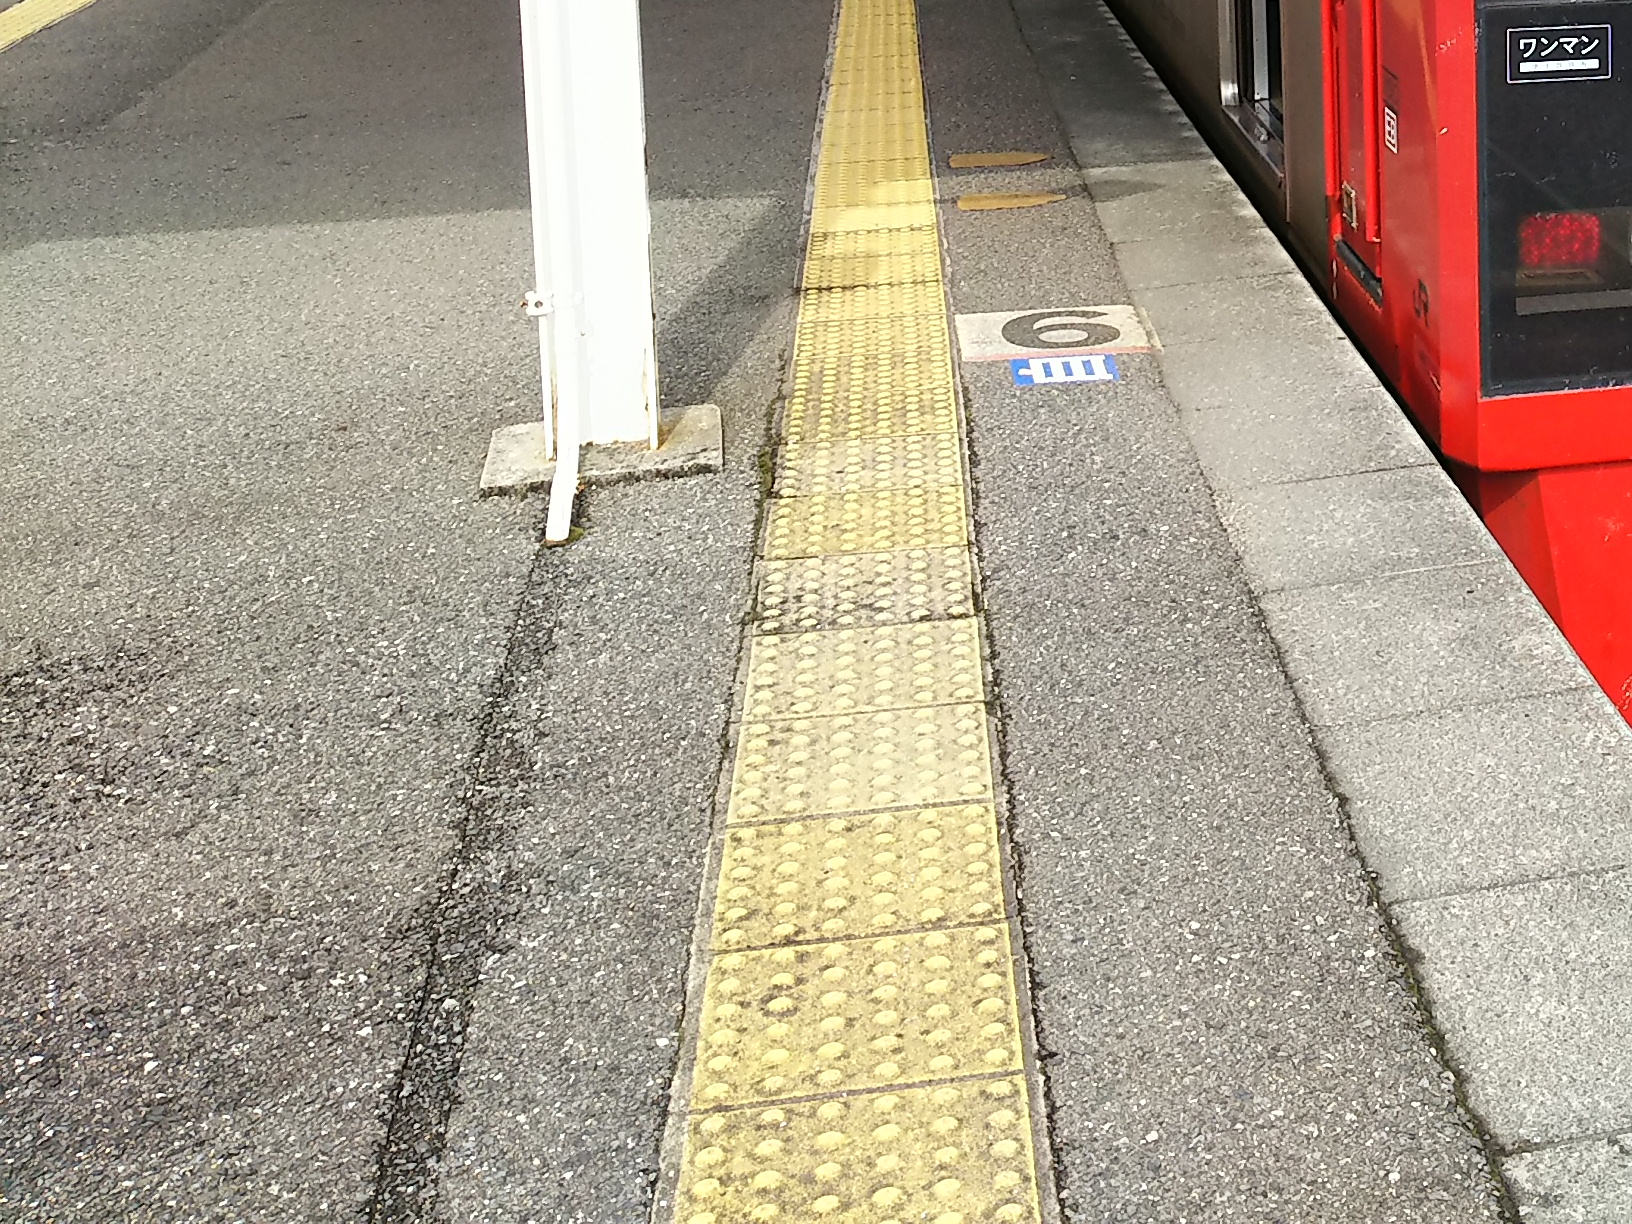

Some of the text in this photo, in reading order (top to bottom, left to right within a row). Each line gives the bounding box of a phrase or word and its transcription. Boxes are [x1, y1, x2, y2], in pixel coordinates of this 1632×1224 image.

[1519, 35, 1600, 58] ワンマン
[1001, 310, 1121, 349] 6
